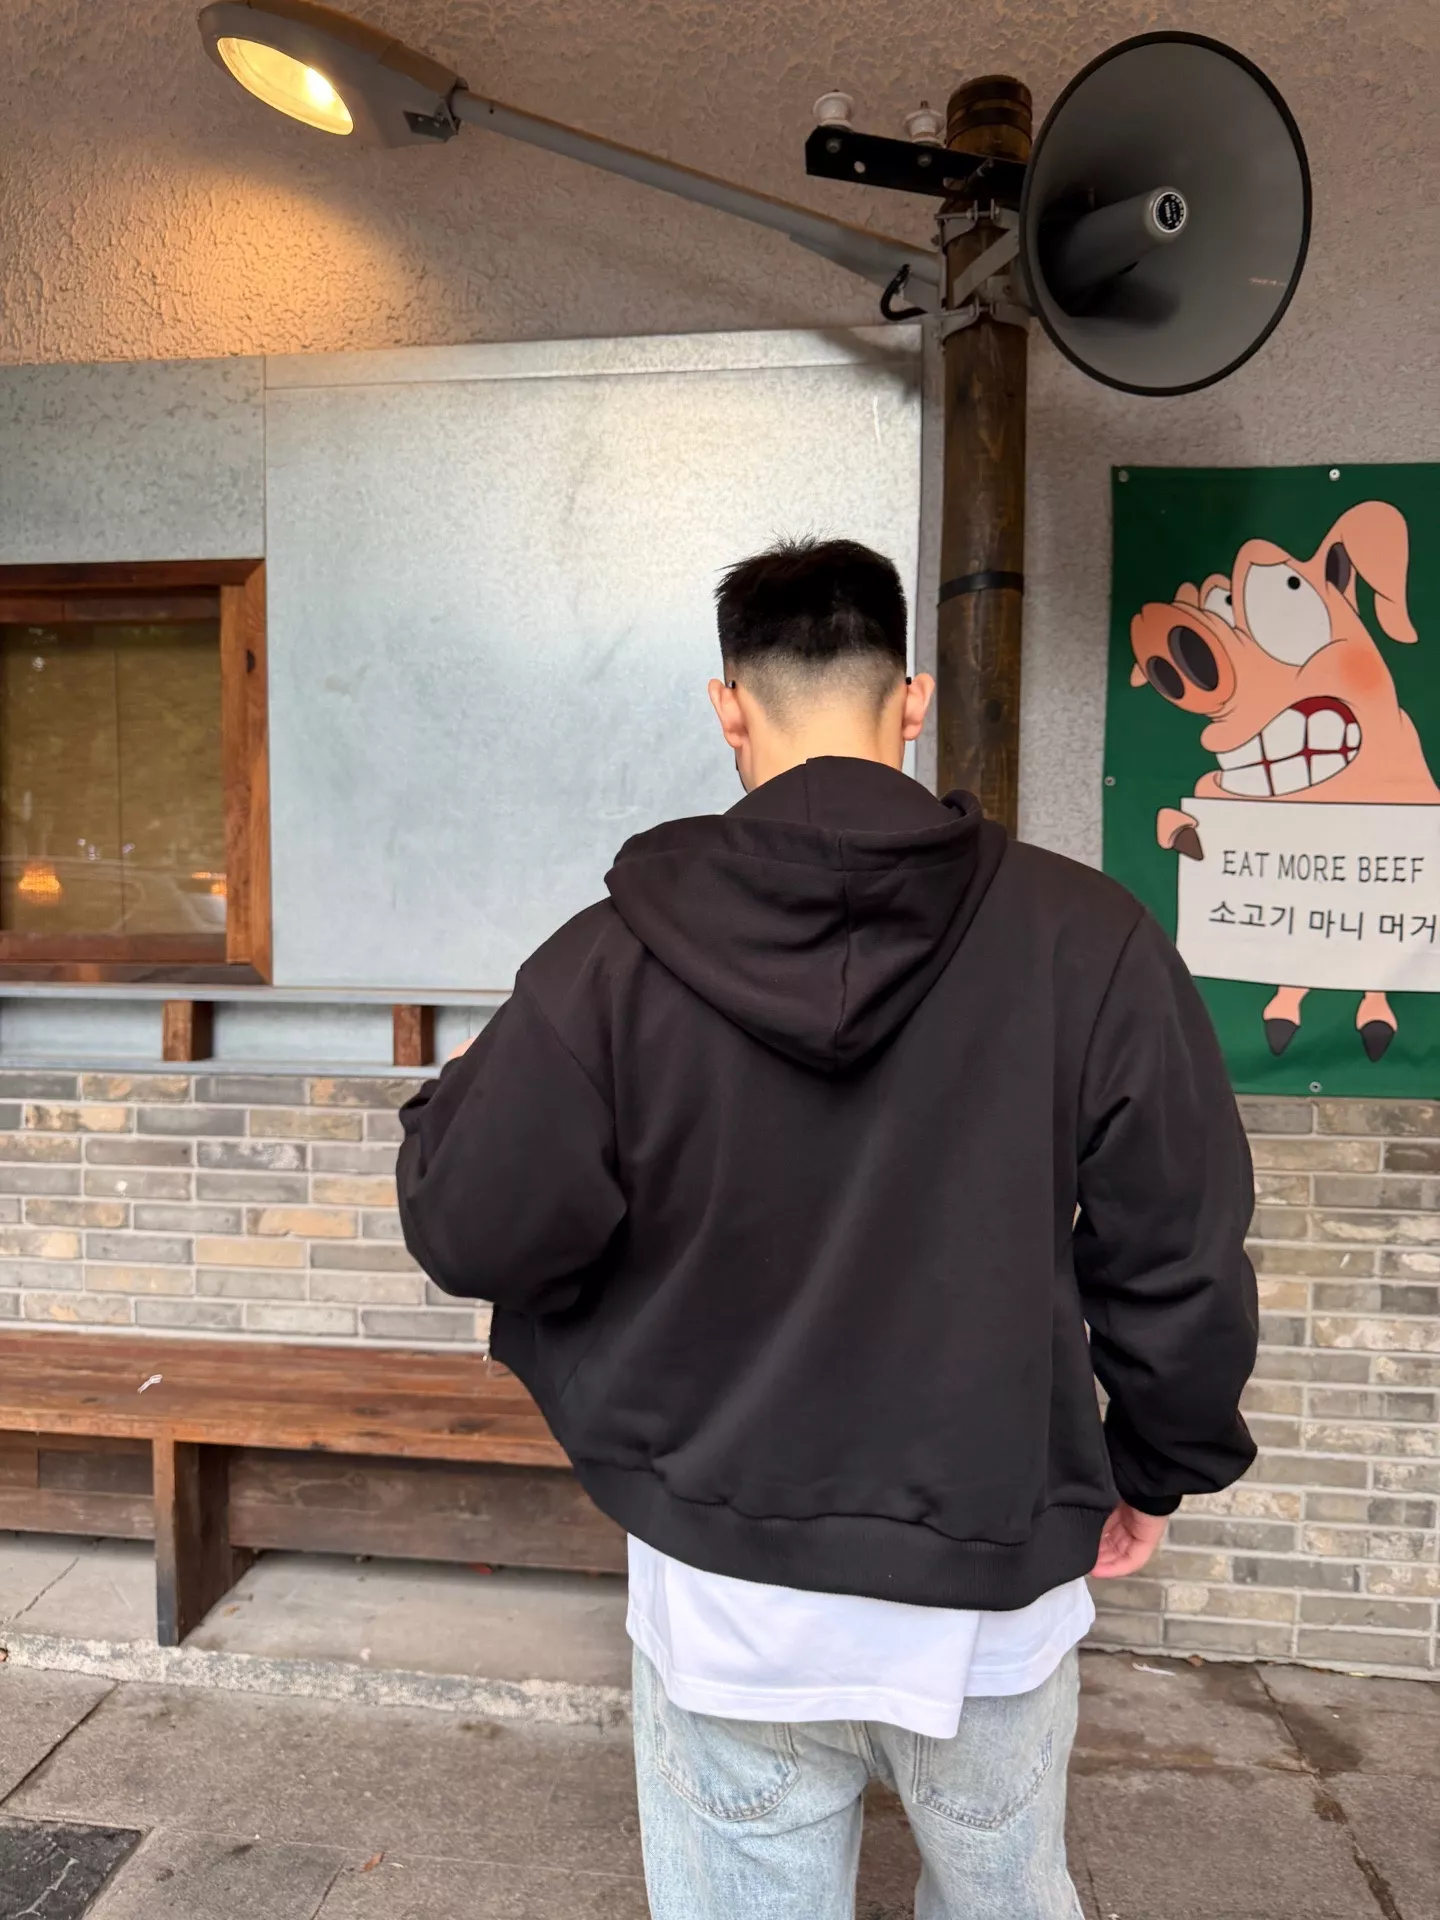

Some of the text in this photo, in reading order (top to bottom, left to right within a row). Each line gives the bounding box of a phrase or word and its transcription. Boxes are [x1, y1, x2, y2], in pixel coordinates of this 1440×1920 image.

[1222, 850, 1425, 883] EAT MORE BEEF
[1208, 900, 1437, 943] 소고기 마니 머거
